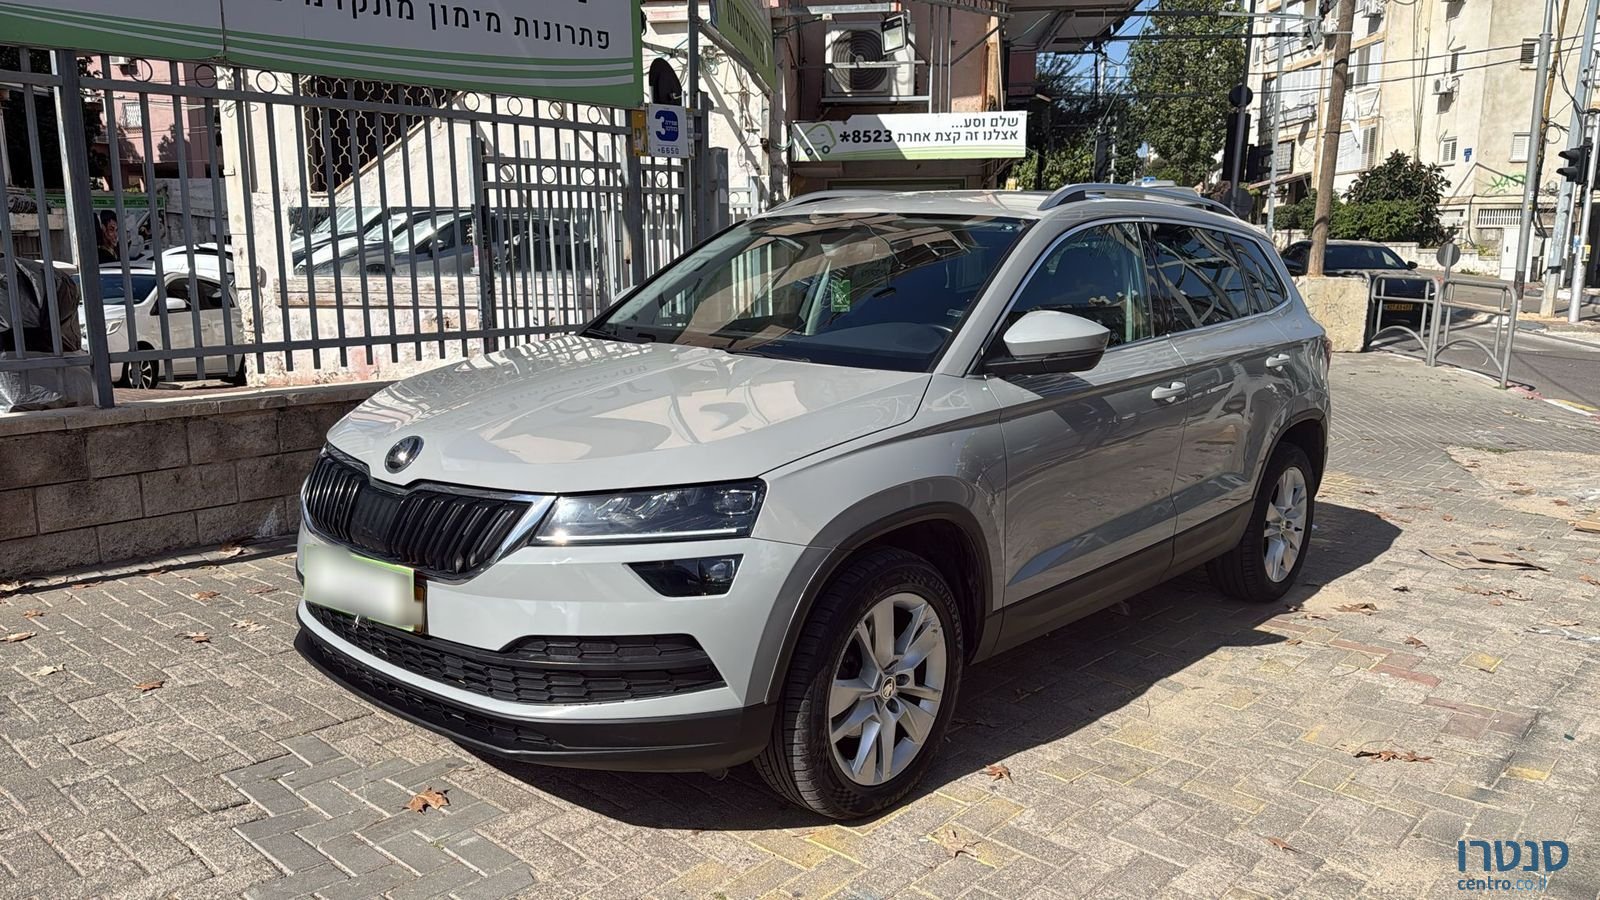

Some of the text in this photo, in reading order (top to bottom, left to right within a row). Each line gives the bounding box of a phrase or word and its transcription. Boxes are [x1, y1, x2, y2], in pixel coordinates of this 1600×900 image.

[429, 3, 502, 34] מימון
[513, 16, 610, 50] פתרונות
[951, 115, 1019, 128] שלם וסע...
[897, 132, 931, 143] אחרת
[934, 132, 961, 144] קצת
[965, 131, 979, 141] זה
[983, 129, 1018, 141] אצלנו
